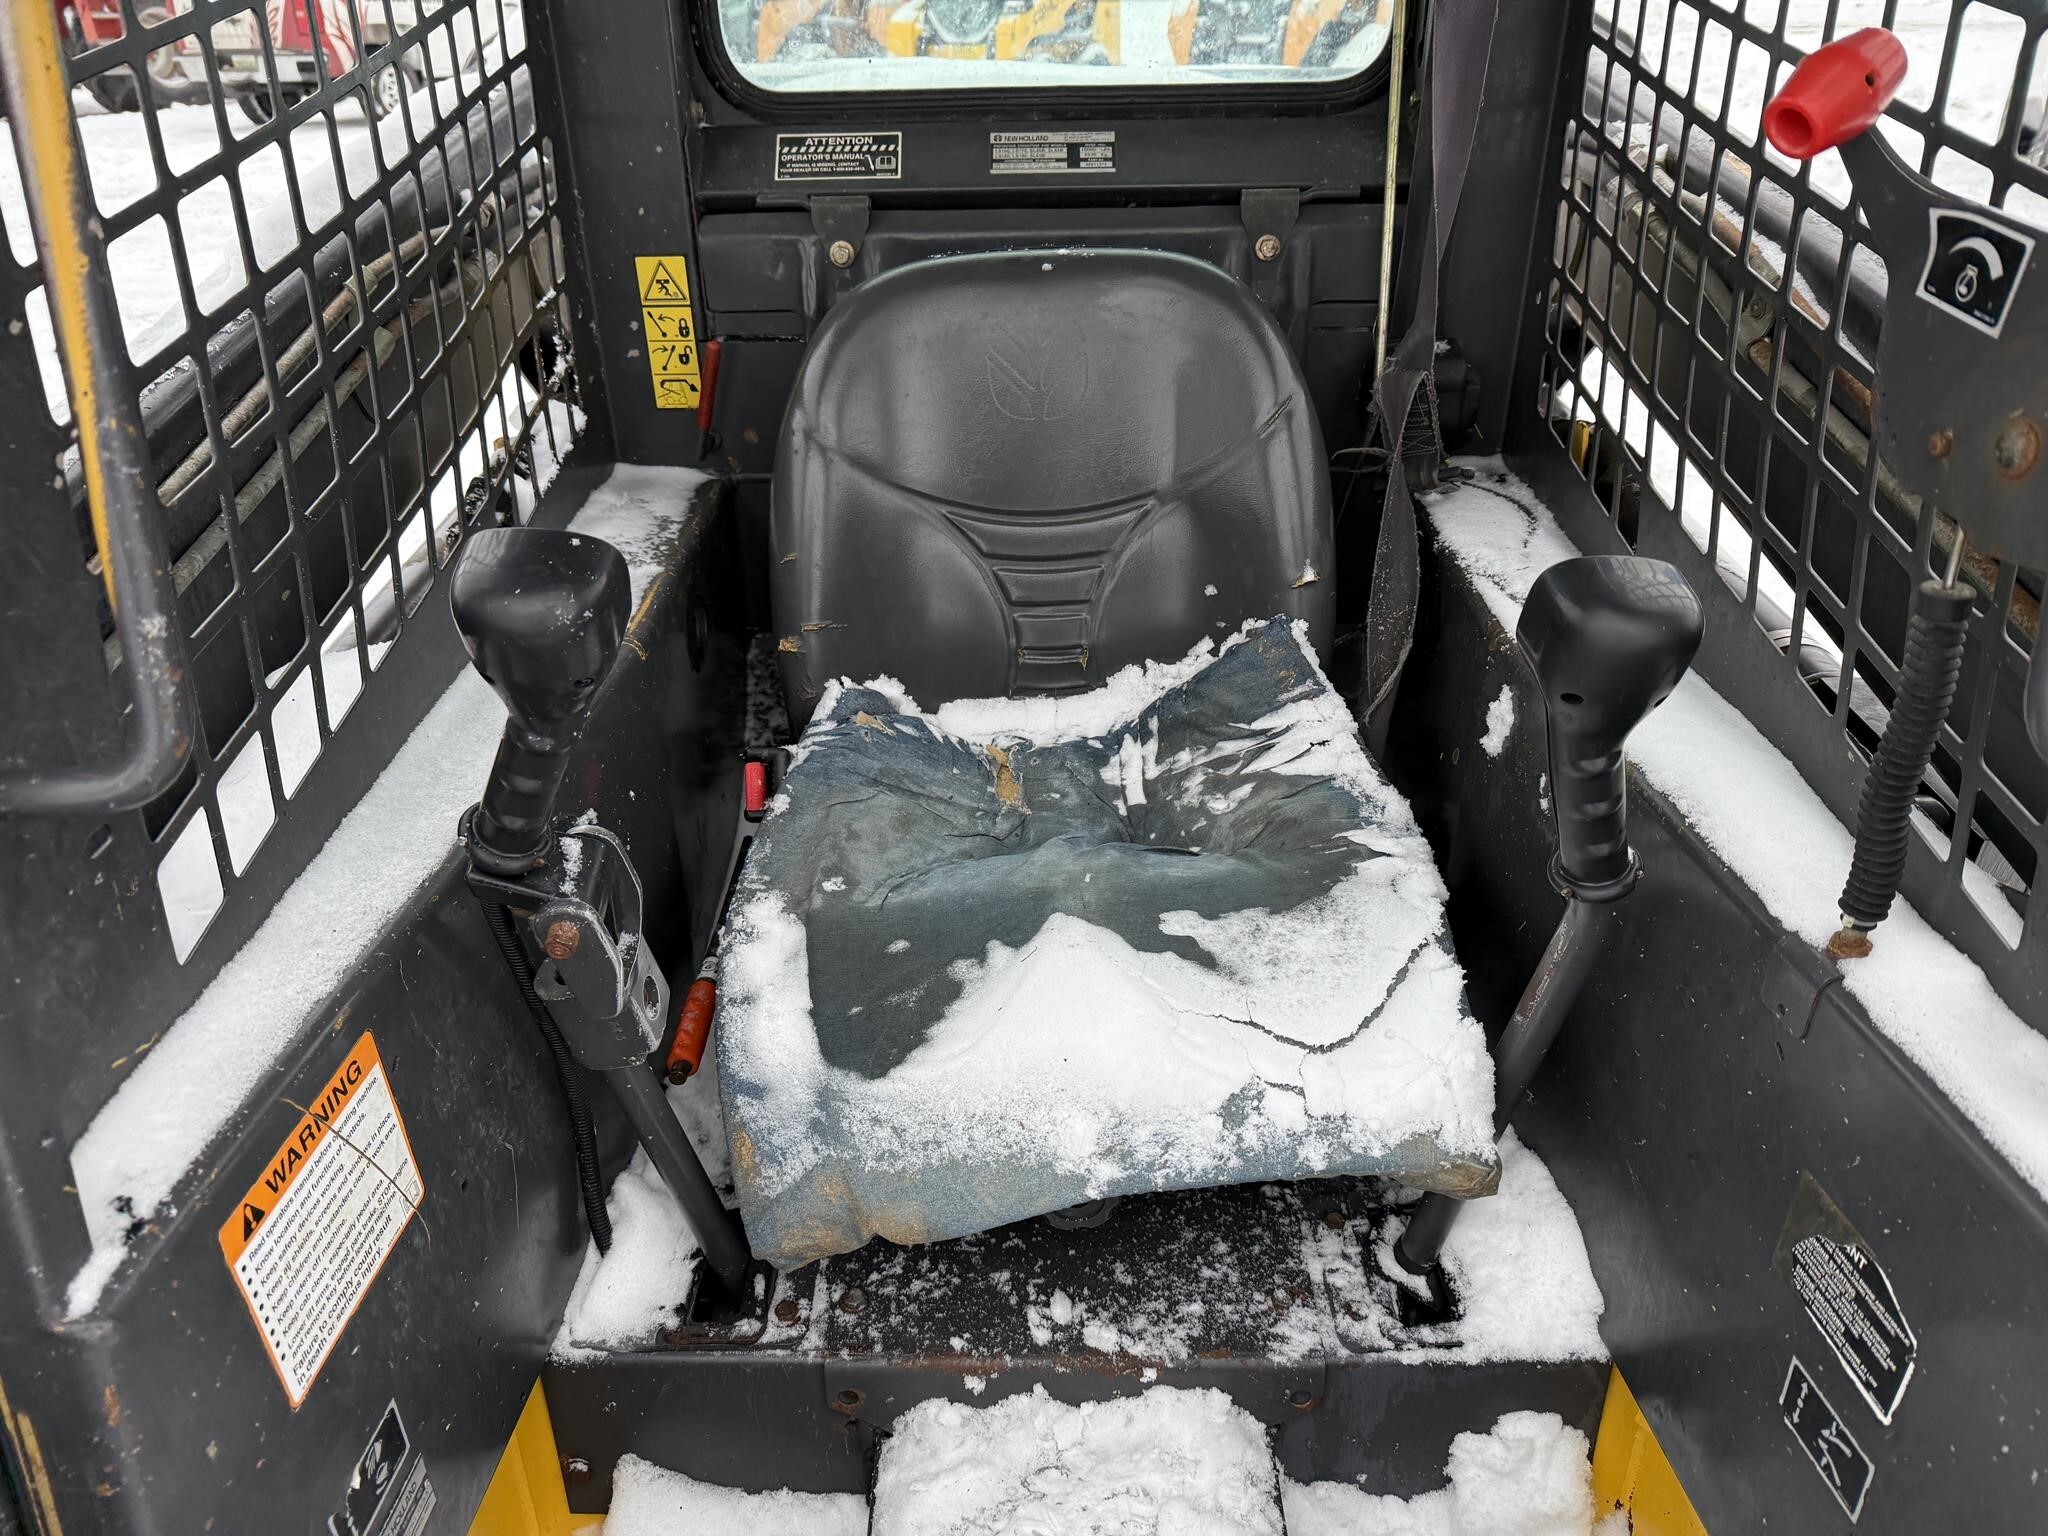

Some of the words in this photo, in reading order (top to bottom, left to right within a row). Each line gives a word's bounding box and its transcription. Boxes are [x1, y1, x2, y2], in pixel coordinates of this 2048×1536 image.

[805, 136, 872, 145] ATTENTION
[248, 1235, 266, 1263] Read
[265, 1195, 294, 1240] operators
[293, 1165, 315, 1199] manual
[314, 1140, 332, 1169] before
[332, 1105, 357, 1144] operating
[356, 1073, 379, 1109] machine.
[255, 1243, 275, 1275] Know
[274, 1207, 300, 1248] location
[299, 1189, 312, 1211] and
[311, 1154, 336, 1193] function
[335, 1144, 343, 1158] of
[342, 1109, 367, 1148] controls.
[265, 1056, 363, 1199] WARNING
[266, 1272, 284, 1301] Keep
[282, 1259, 292, 1276] all
[291, 1224, 315, 1264] shields,
[314, 1191, 337, 1228] screens
[336, 1174, 349, 1195] and
[348, 1139, 372, 1179] windows
[371, 1130, 378, 1144] in
[377, 1108, 392, 1135] place.
[260, 1259, 279, 1289] Keep
[277, 1230, 298, 1263] safety
[297, 1196, 321, 1234] devices
[320, 1159, 346, 1200] working.
[271, 1285, 289, 1314] Keep
[287, 1248, 312, 1289] children
[311, 1231, 324, 1253] and
[323, 1186, 354, 1235] bystanders
[352, 1165, 367, 1190] clear
[366, 1156, 373, 1170] of
[372, 1137, 385, 1161] work
[384, 1119, 397, 1142] area.
[277, 1297, 294, 1326] Keep
[293, 1268, 313, 1301] riders
[312, 1254, 322, 1273] off
[321, 1214, 348, 1258] machine.
[282, 1309, 300, 1339] Keep
[298, 1290, 312, 1313] cab
[311, 1262, 329, 1294] clean,
[328, 1219, 357, 1267] especially
[356, 1195, 372, 1224] pedal
[371, 1175, 385, 1200] area.
[287, 1317, 307, 1351] Lower
[306, 1304, 315, 1322] lift
[314, 1279, 331, 1308] arms,
[330, 1247, 351, 1283] engage
[350, 1228, 363, 1252] park
[377, 1180, 393, 1208] STOP
[392, 1156, 408, 1185] engine
[291, 1336, 305, 1360] and
[303, 1300, 327, 1340] remove
[326, 1283, 338, 1305] key
[337, 1254, 356, 1287] before
[355, 1223, 375, 1258] leaving
[374, 1187, 397, 1227] machine.
[293, 1332, 319, 1378] Failure
[318, 1317, 328, 1336] to
[327, 1275, 354, 1322] comply
[353, 1243, 373, 1279] could
[372, 1213, 392, 1248] result
[297, 1369, 306, 1388] in
[305, 1334, 328, 1374] death
[326, 1319, 337, 1339] or
[335, 1277, 362, 1324] serious
[361, 1242, 383, 1282] injury.
